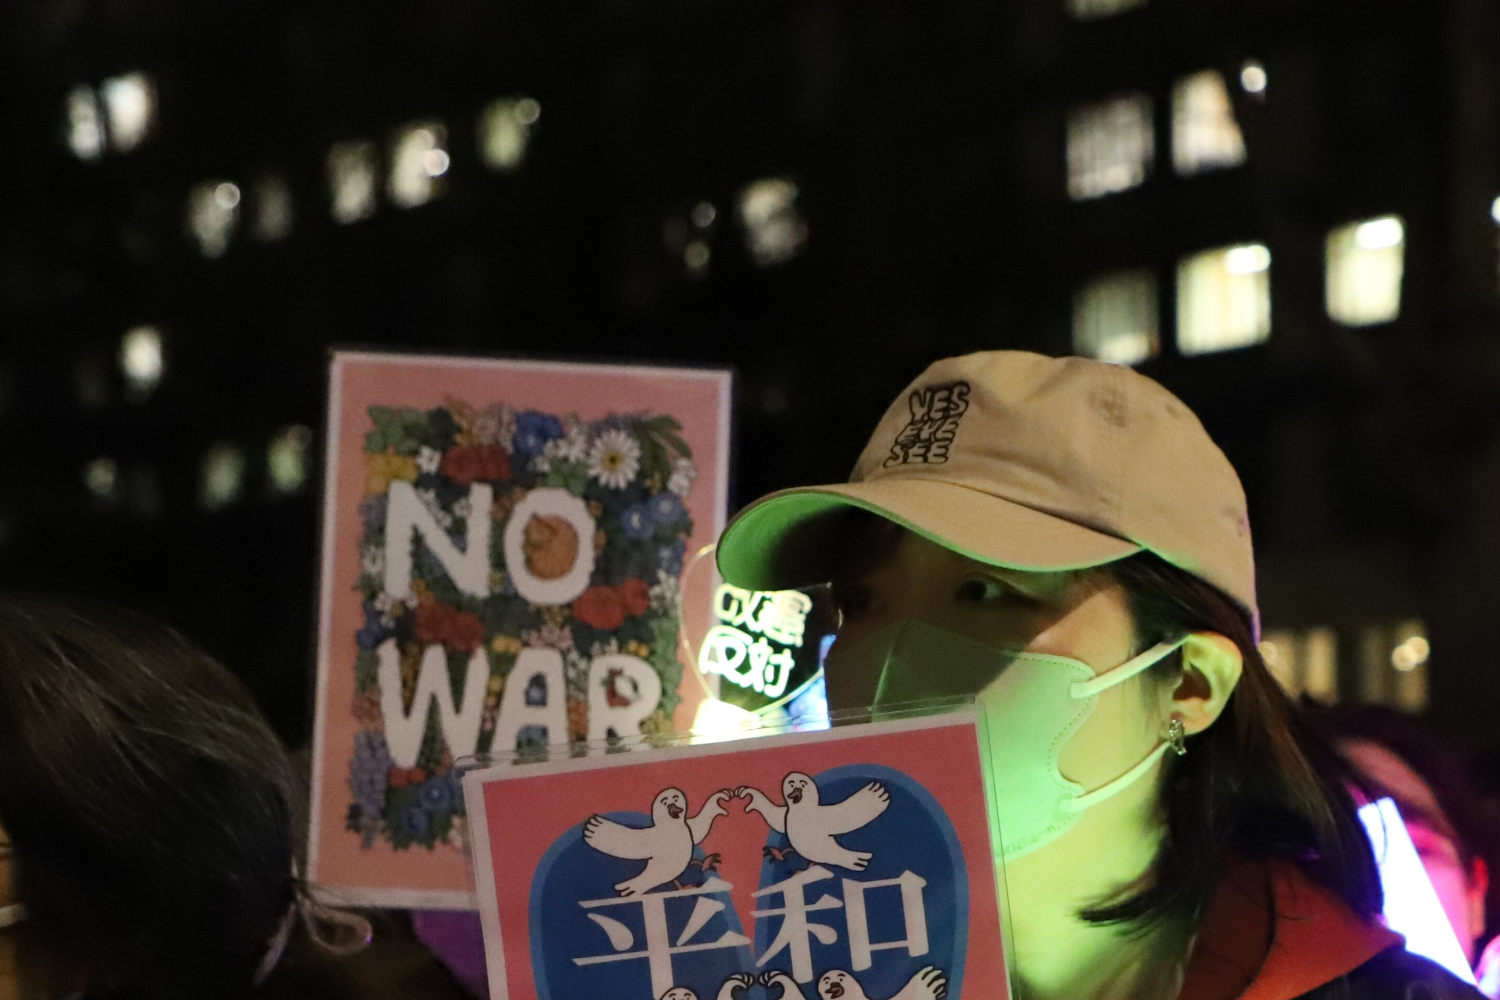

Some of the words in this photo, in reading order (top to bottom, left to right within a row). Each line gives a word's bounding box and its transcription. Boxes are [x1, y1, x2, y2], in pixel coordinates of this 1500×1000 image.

[908, 381, 970, 424] YES
[883, 441, 949, 468] SEE
[384, 478, 596, 605] NO
[377, 640, 663, 770] WAR
[698, 624, 795, 697] 反対
[572, 868, 929, 1000] 平和
